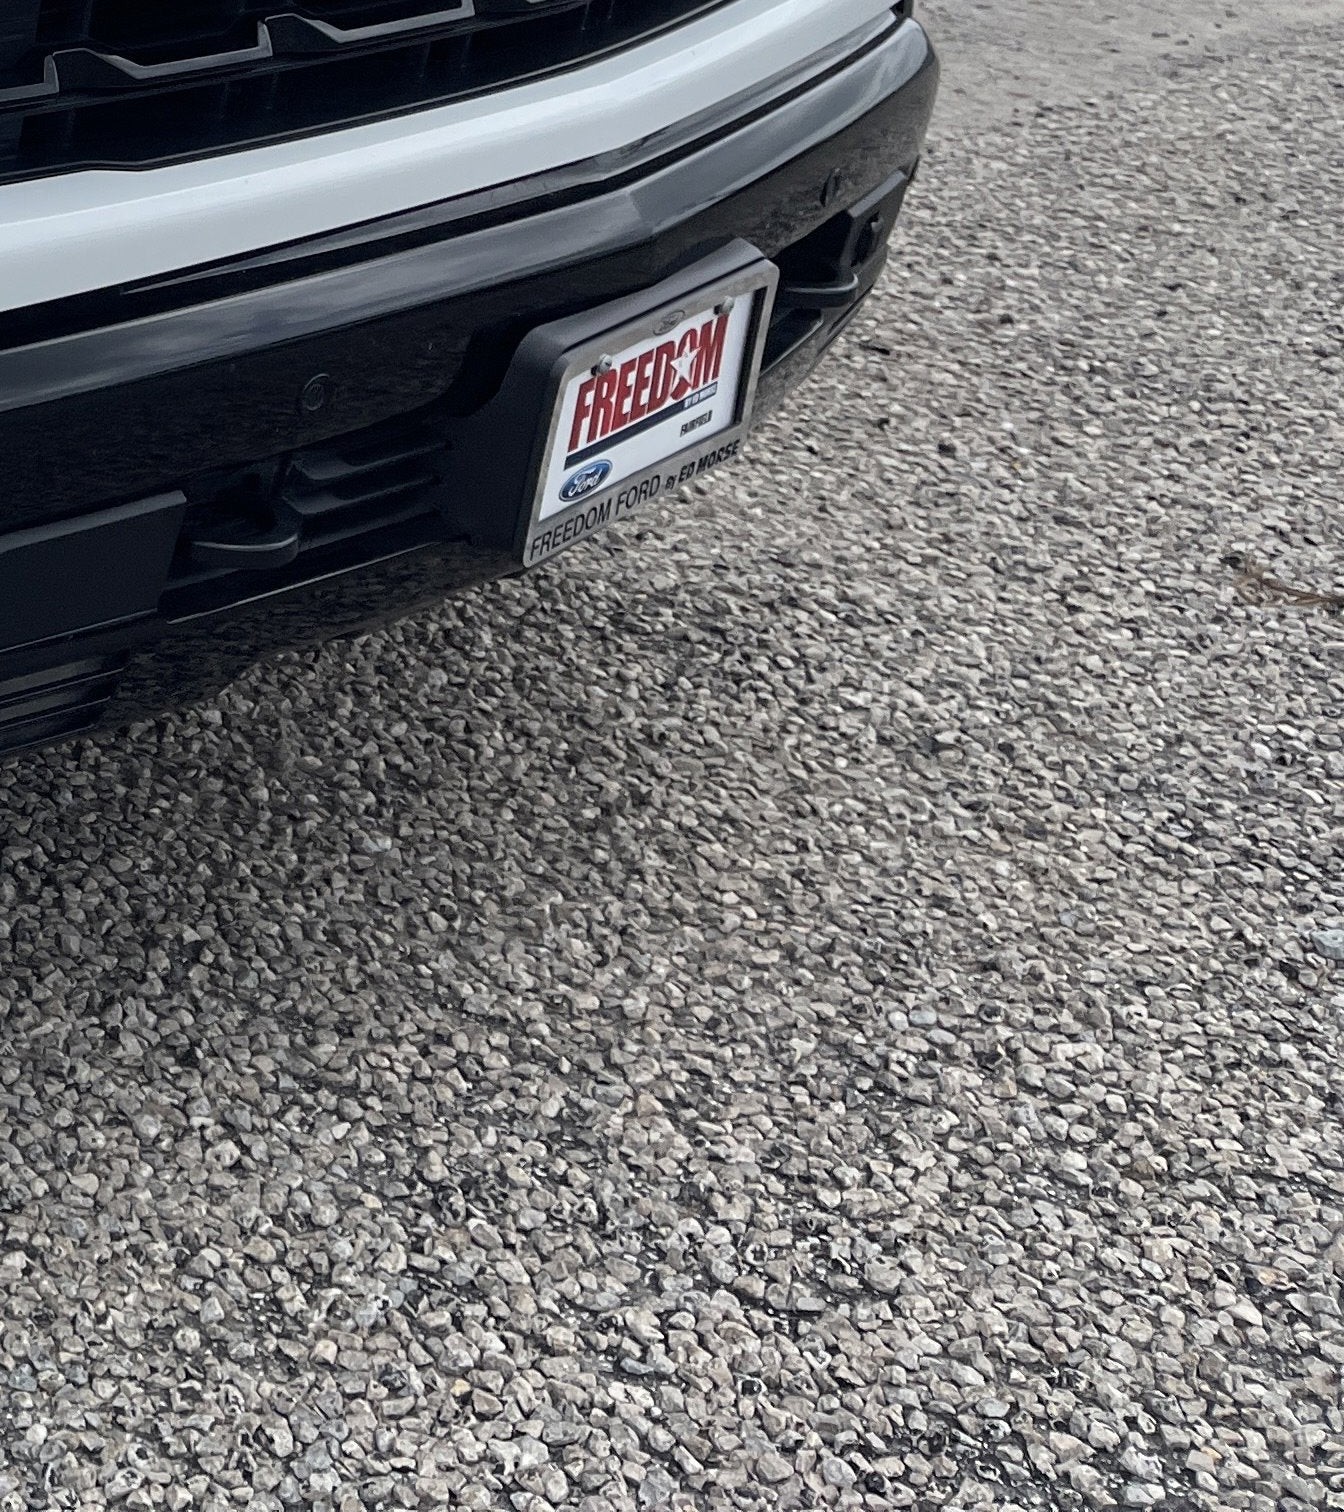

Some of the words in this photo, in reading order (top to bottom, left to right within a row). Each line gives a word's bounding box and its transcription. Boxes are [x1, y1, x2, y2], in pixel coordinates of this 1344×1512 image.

[568, 313, 729, 453] FREEDOM
[529, 497, 612, 561] FREEDOM
[615, 474, 661, 516] FORD
[678, 461, 696, 483] ED
[696, 437, 741, 475] MORSE
[566, 464, 605, 497] Ford
